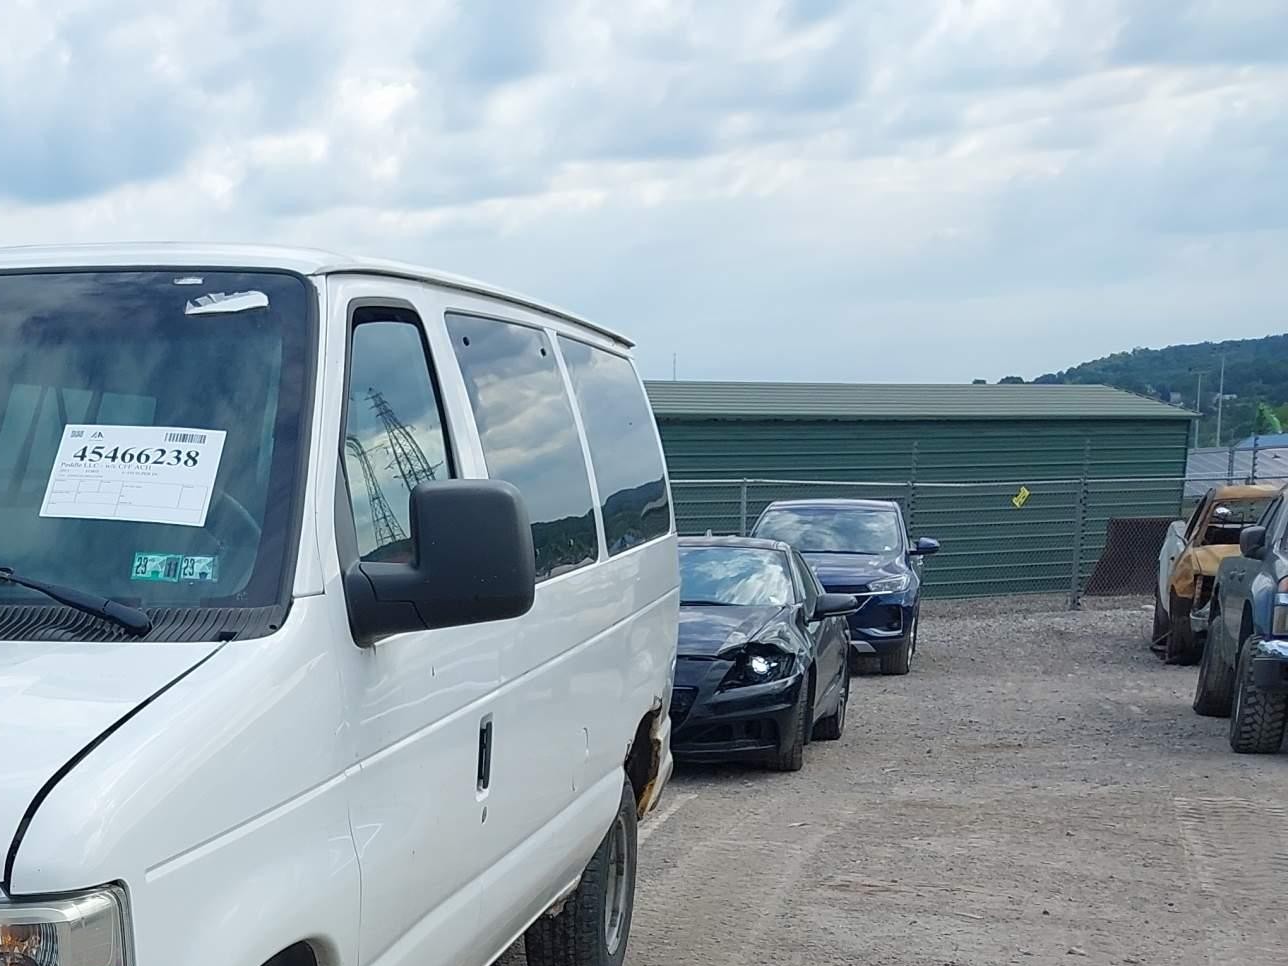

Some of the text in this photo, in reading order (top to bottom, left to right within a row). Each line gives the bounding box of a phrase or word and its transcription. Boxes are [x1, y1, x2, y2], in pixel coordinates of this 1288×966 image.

[73, 445, 200, 468] 45466238
[135, 557, 149, 575] 23
[183, 558, 195, 576] 23
